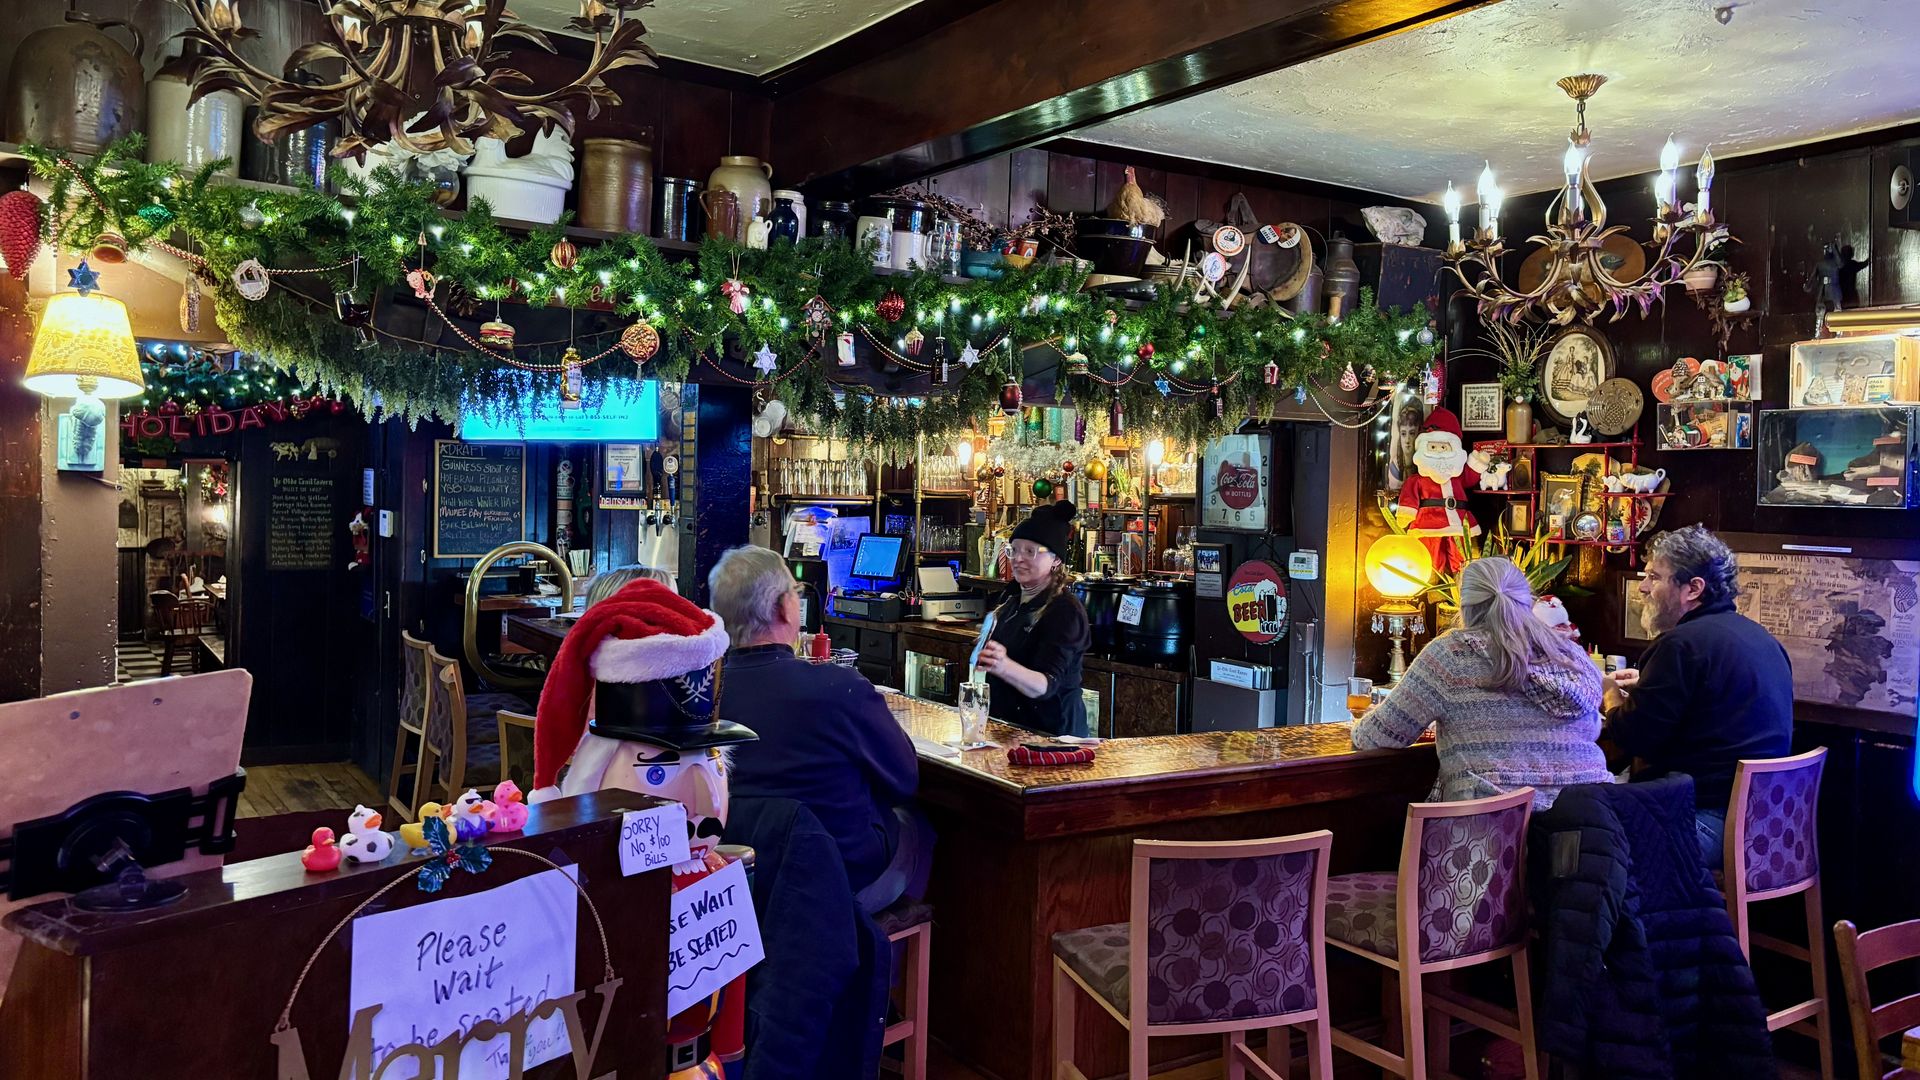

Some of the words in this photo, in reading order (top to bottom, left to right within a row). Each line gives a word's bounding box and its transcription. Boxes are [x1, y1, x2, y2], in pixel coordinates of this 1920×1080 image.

[120, 394, 311, 439] HOLIDAYS
[442, 460, 481, 472] GUINNESS
[1262, 456, 1268, 466] 2
[1211, 475, 1217, 485] 9
[1261, 476, 1268, 487] 3
[1220, 472, 1257, 489] Coca-Cola
[601, 497, 646, 507] DEUTSCHLAND
[1211, 495, 1217, 505] 8
[1222, 509, 1228, 519] 7
[1235, 511, 1241, 521] 6
[1249, 510, 1255, 521] 5
[1759, 553, 1788, 562] DAYTON
[1790, 554, 1811, 563] DAILY
[1814, 556, 1836, 565] NEWS
[1232, 599, 1267, 623] BEER
[690, 885, 735, 921] WAIT
[687, 919, 737, 961] SEATED
[417, 922, 507, 971] Please
